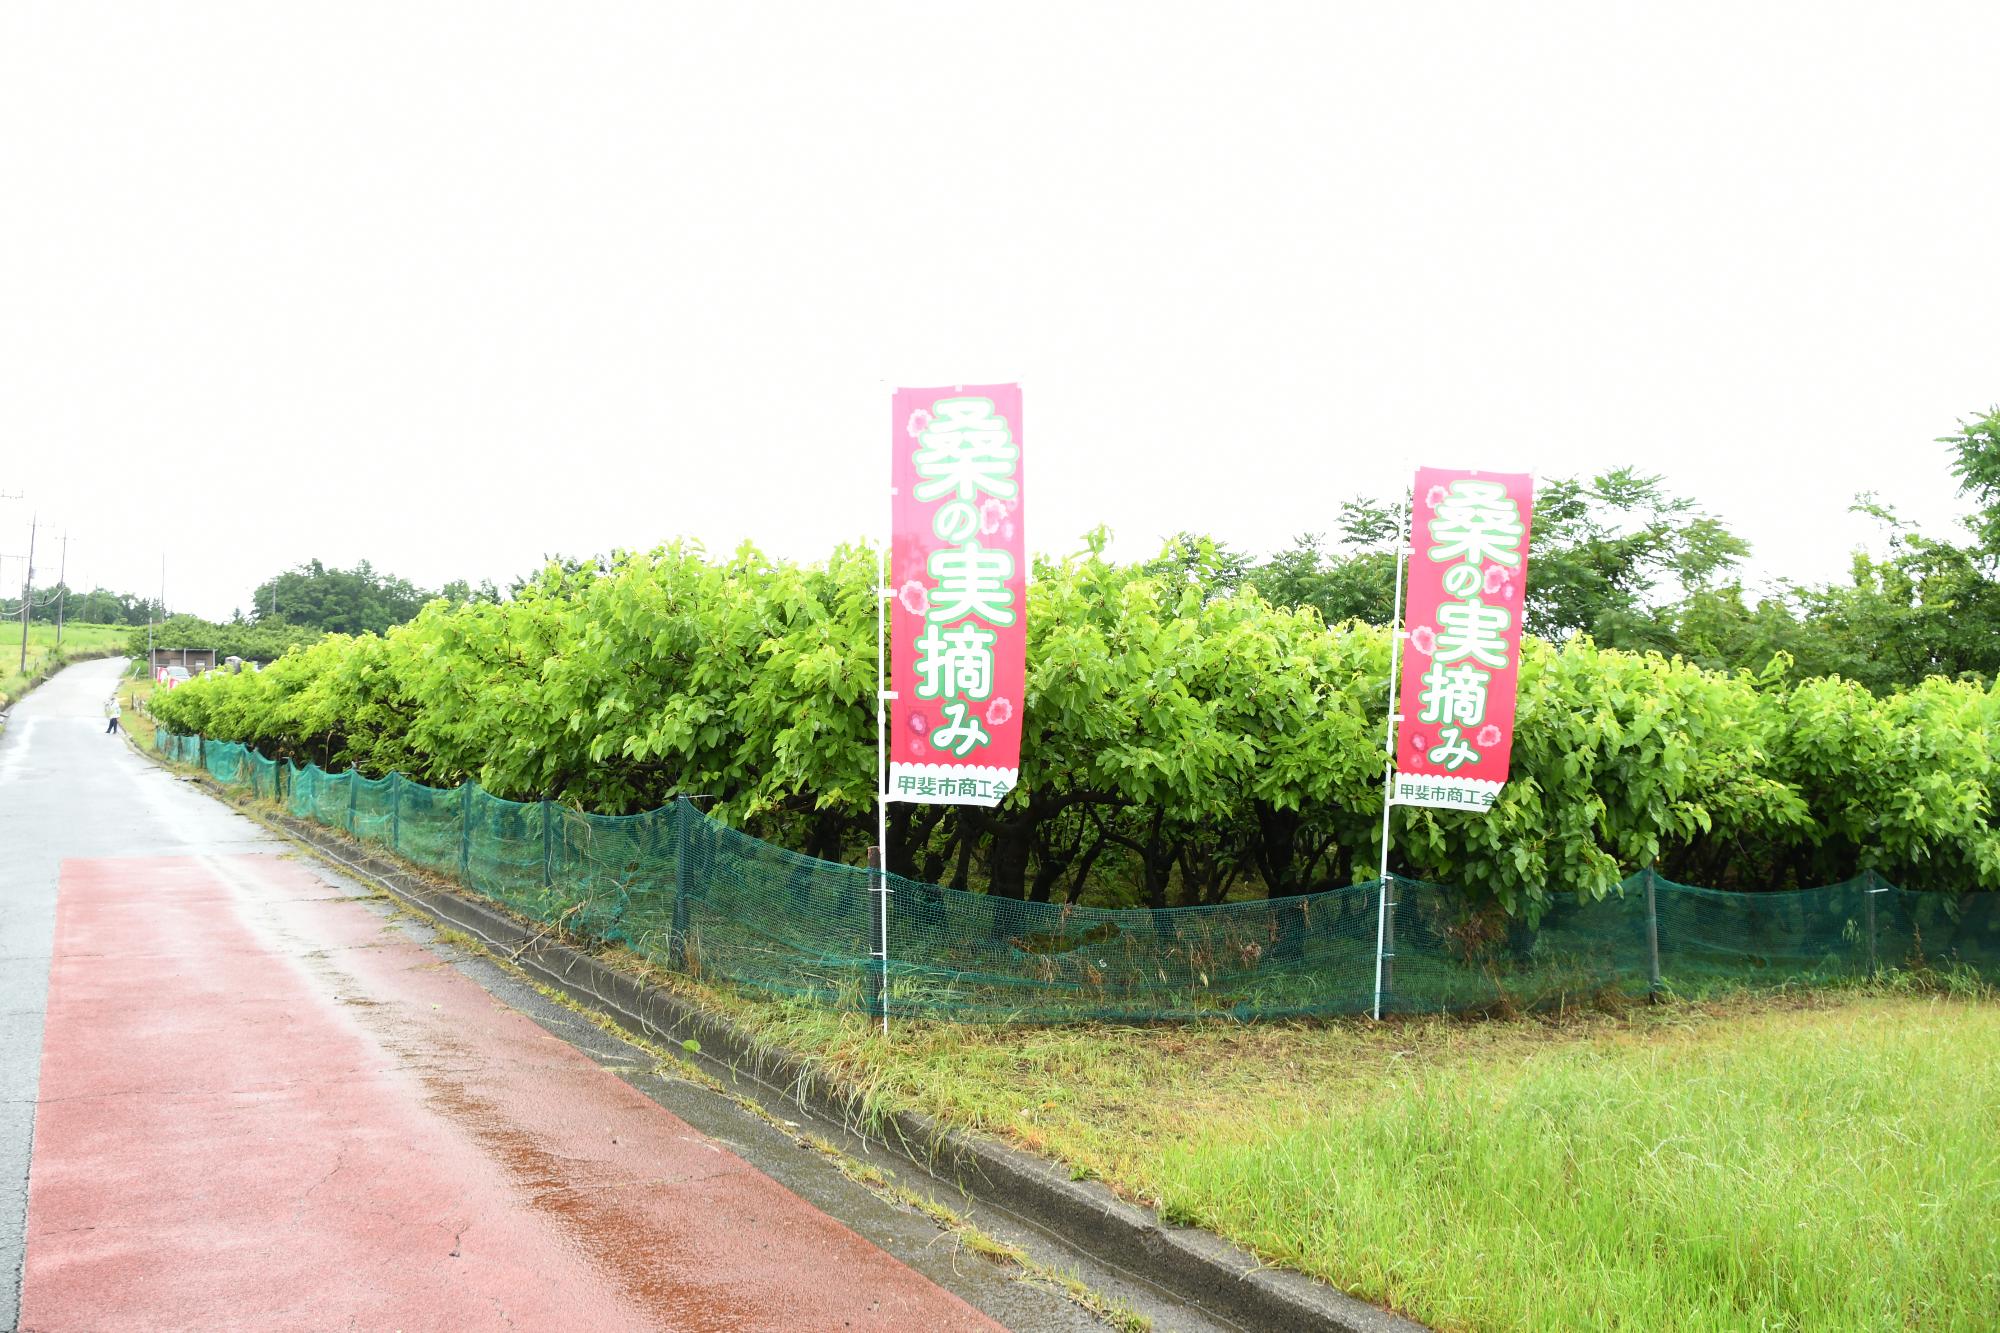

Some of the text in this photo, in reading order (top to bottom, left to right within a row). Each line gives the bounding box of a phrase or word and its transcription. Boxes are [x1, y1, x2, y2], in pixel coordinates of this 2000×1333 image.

[913, 397, 1018, 757] 桑の実摘み
[1418, 480, 1525, 771] 桑の実摘み
[898, 775, 1010, 799] 甲斐市商工会
[1400, 783, 1497, 806] 甲斐市商工会
